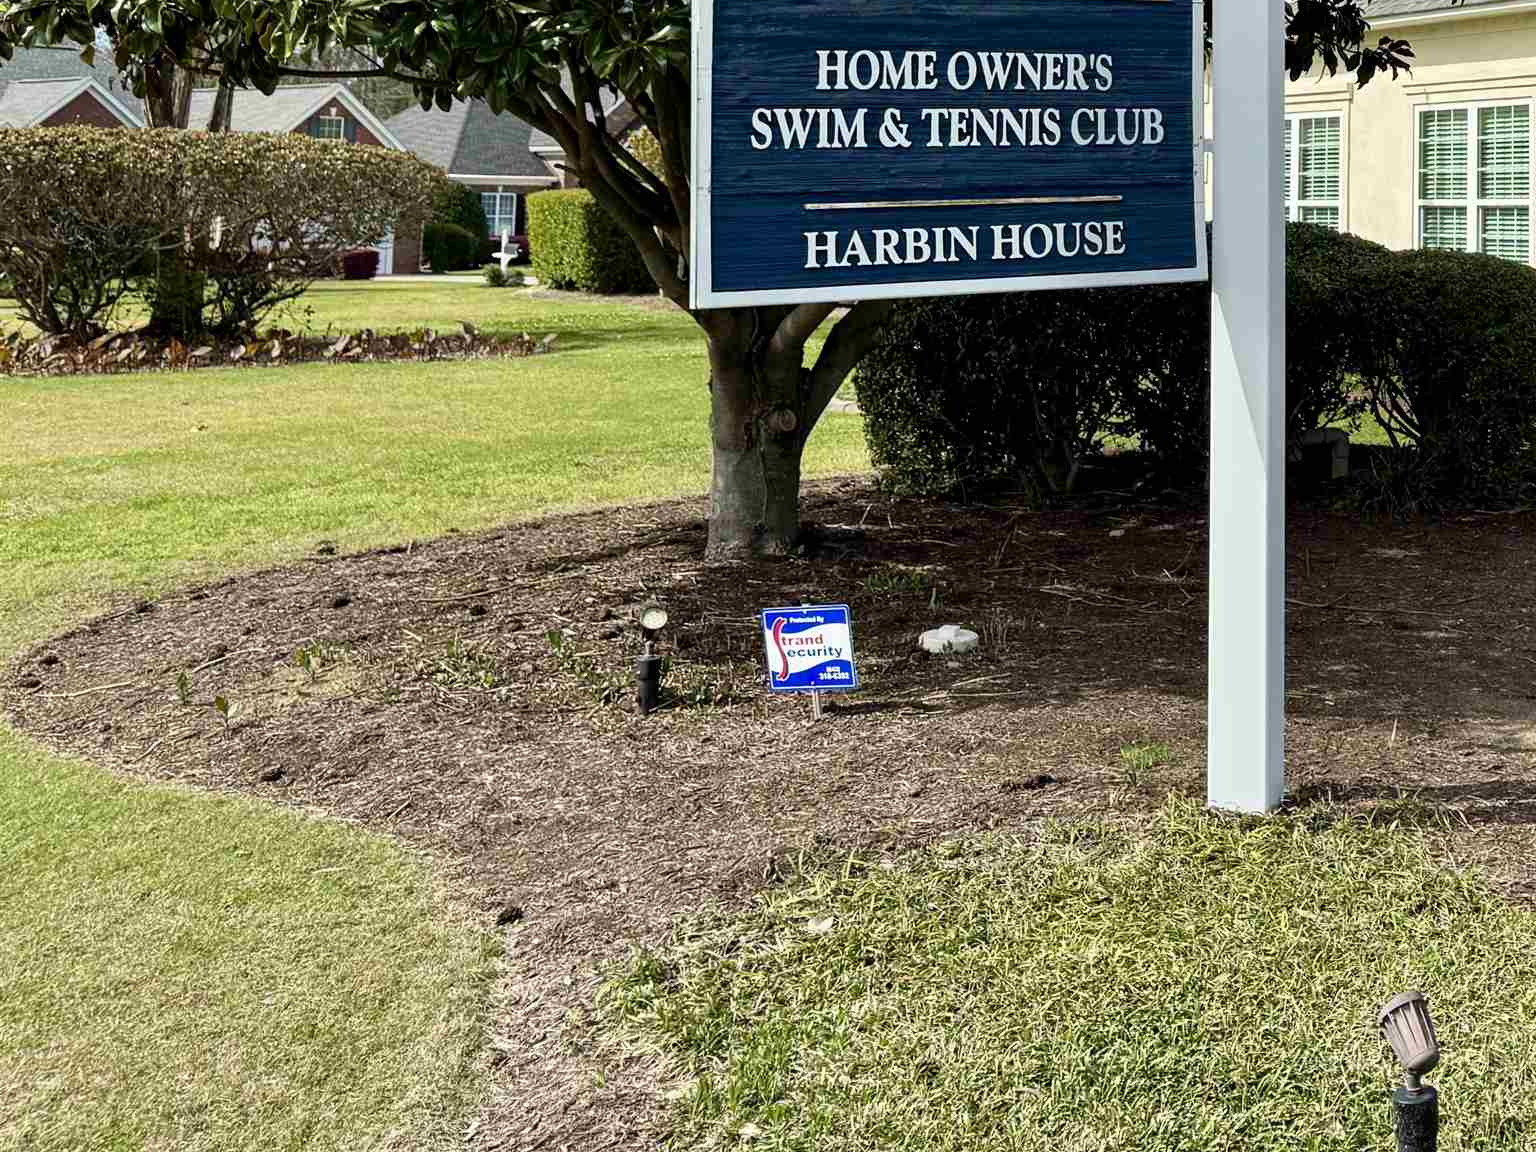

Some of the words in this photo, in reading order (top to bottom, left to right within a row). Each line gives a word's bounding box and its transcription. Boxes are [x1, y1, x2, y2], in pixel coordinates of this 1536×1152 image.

[816, 50, 937, 89] HOME
[947, 51, 1112, 91] OWNER'S
[751, 108, 867, 149] SWIM
[879, 108, 911, 147] &
[922, 108, 1060, 146] TENNIS
[1071, 108, 1163, 145] CLUB
[804, 226, 979, 268] HARBIN
[991, 222, 1125, 259] HOUSE
